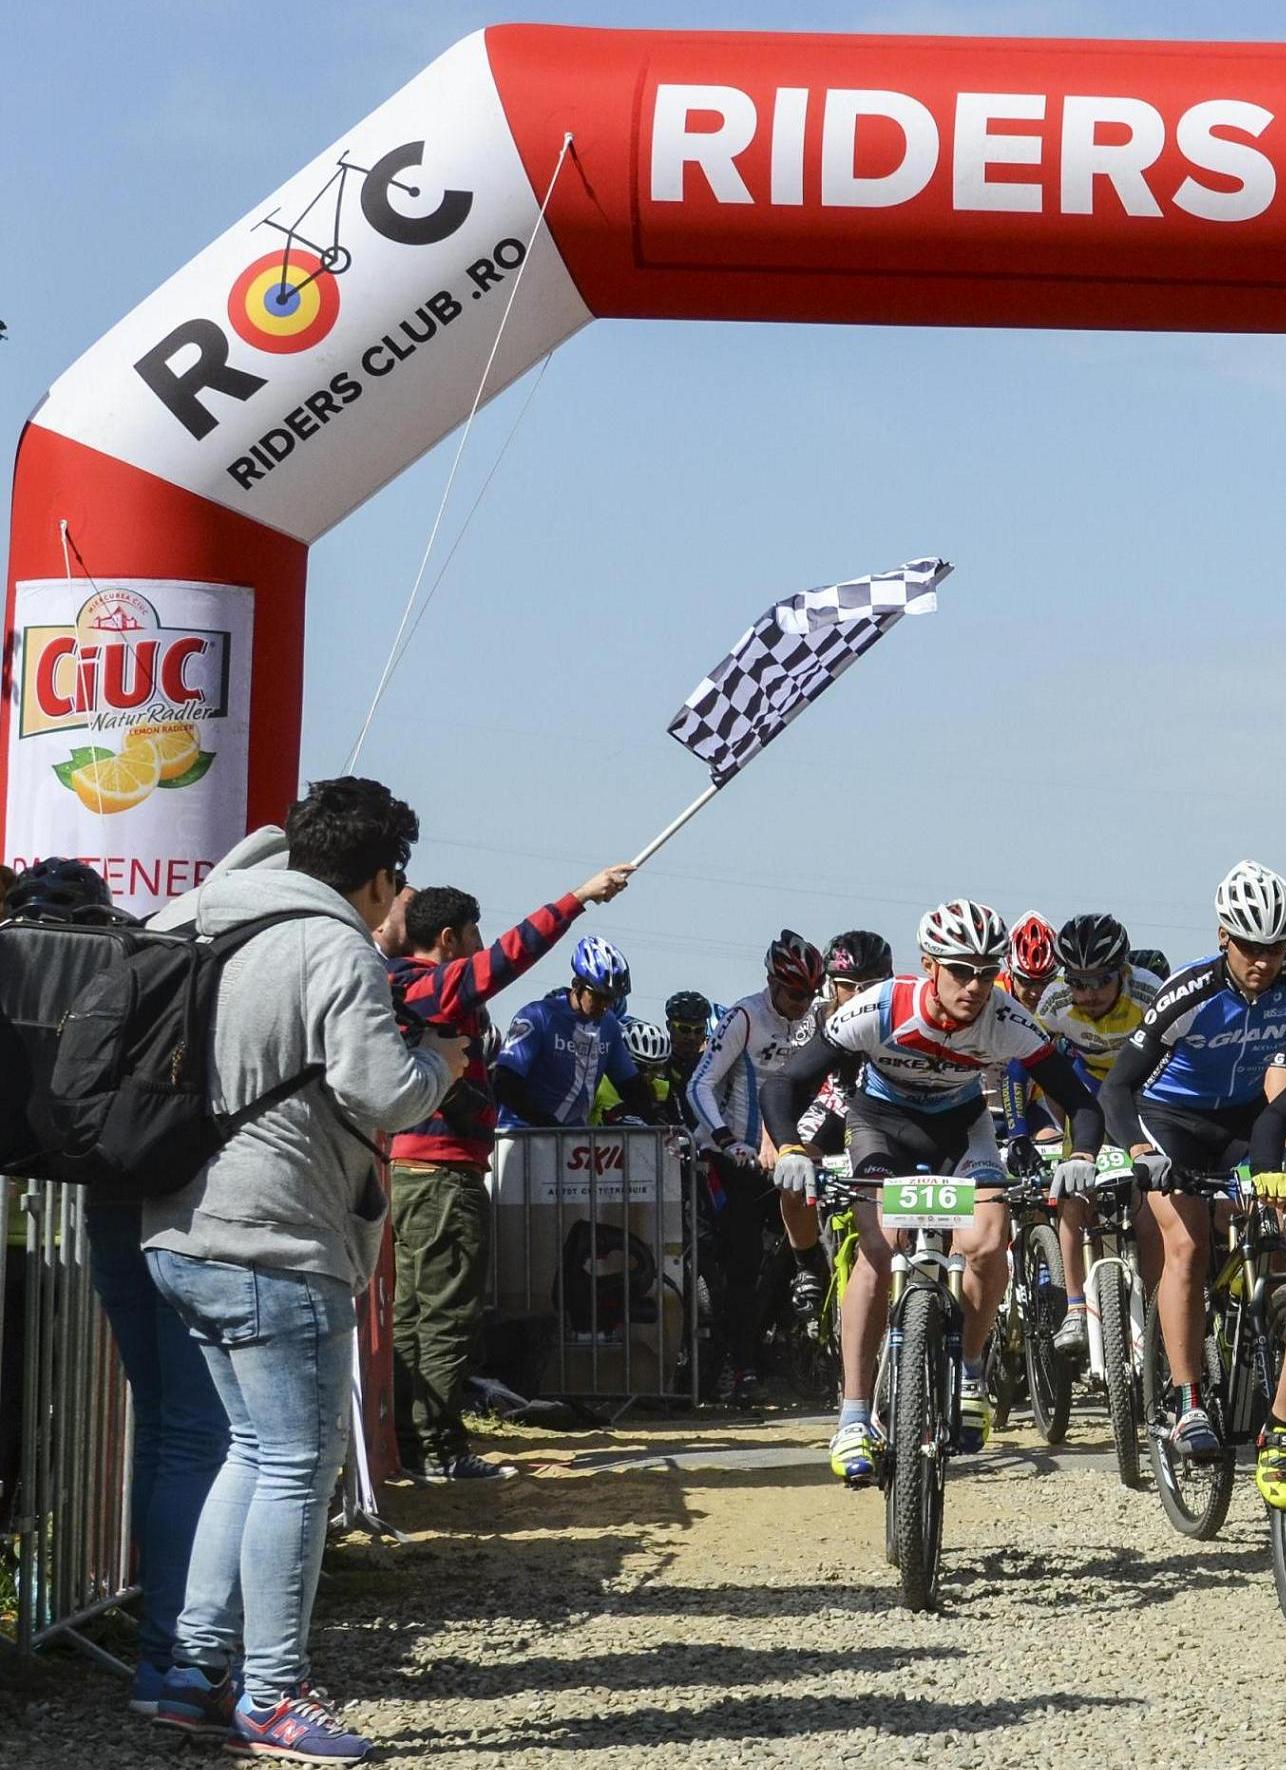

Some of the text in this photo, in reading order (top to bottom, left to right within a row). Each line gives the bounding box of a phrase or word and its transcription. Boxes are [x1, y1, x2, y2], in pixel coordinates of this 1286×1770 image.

[649, 84, 1278, 222] RIDERS
[226, 372, 363, 490] RIDERS
[840, 1000, 890, 1023] CUBE
[1156, 970, 1213, 1013] GIANT
[899, 1186, 957, 1209] 516
